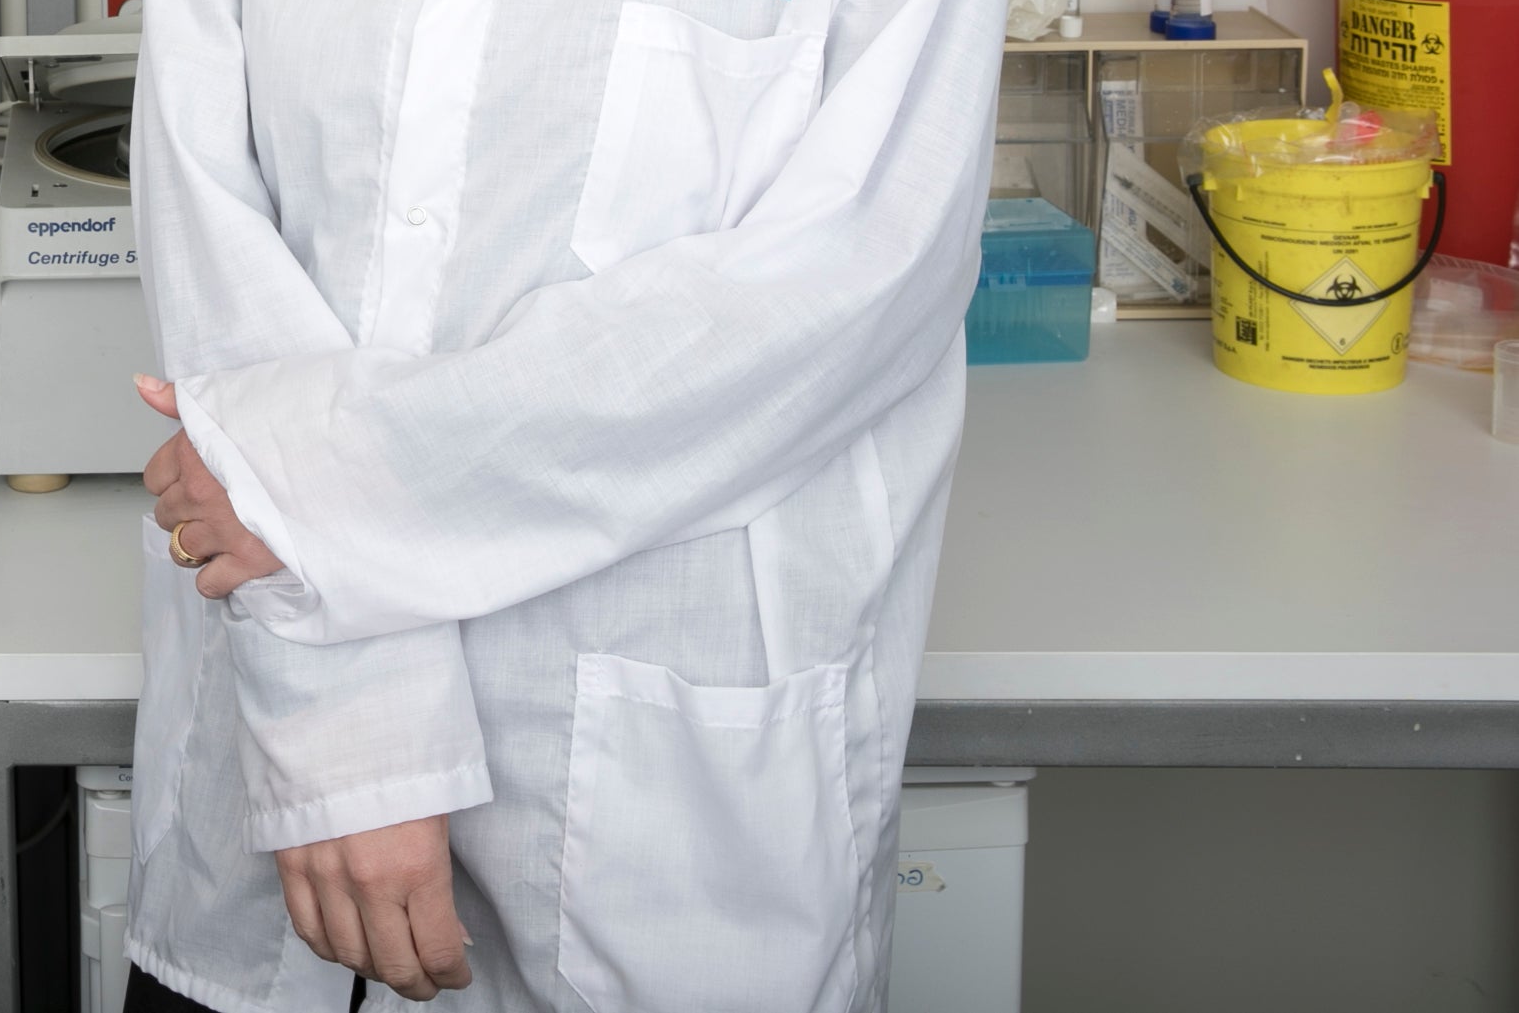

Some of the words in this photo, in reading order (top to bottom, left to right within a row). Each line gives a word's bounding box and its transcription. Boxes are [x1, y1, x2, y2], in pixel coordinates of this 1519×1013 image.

[1351, 10, 1416, 41] DANGER
[1350, 32, 1417, 63] זהירות
[27, 217, 116, 237] eppendorf
[28, 250, 120, 267] Centrifuge
[125, 250, 138, 263] 5
